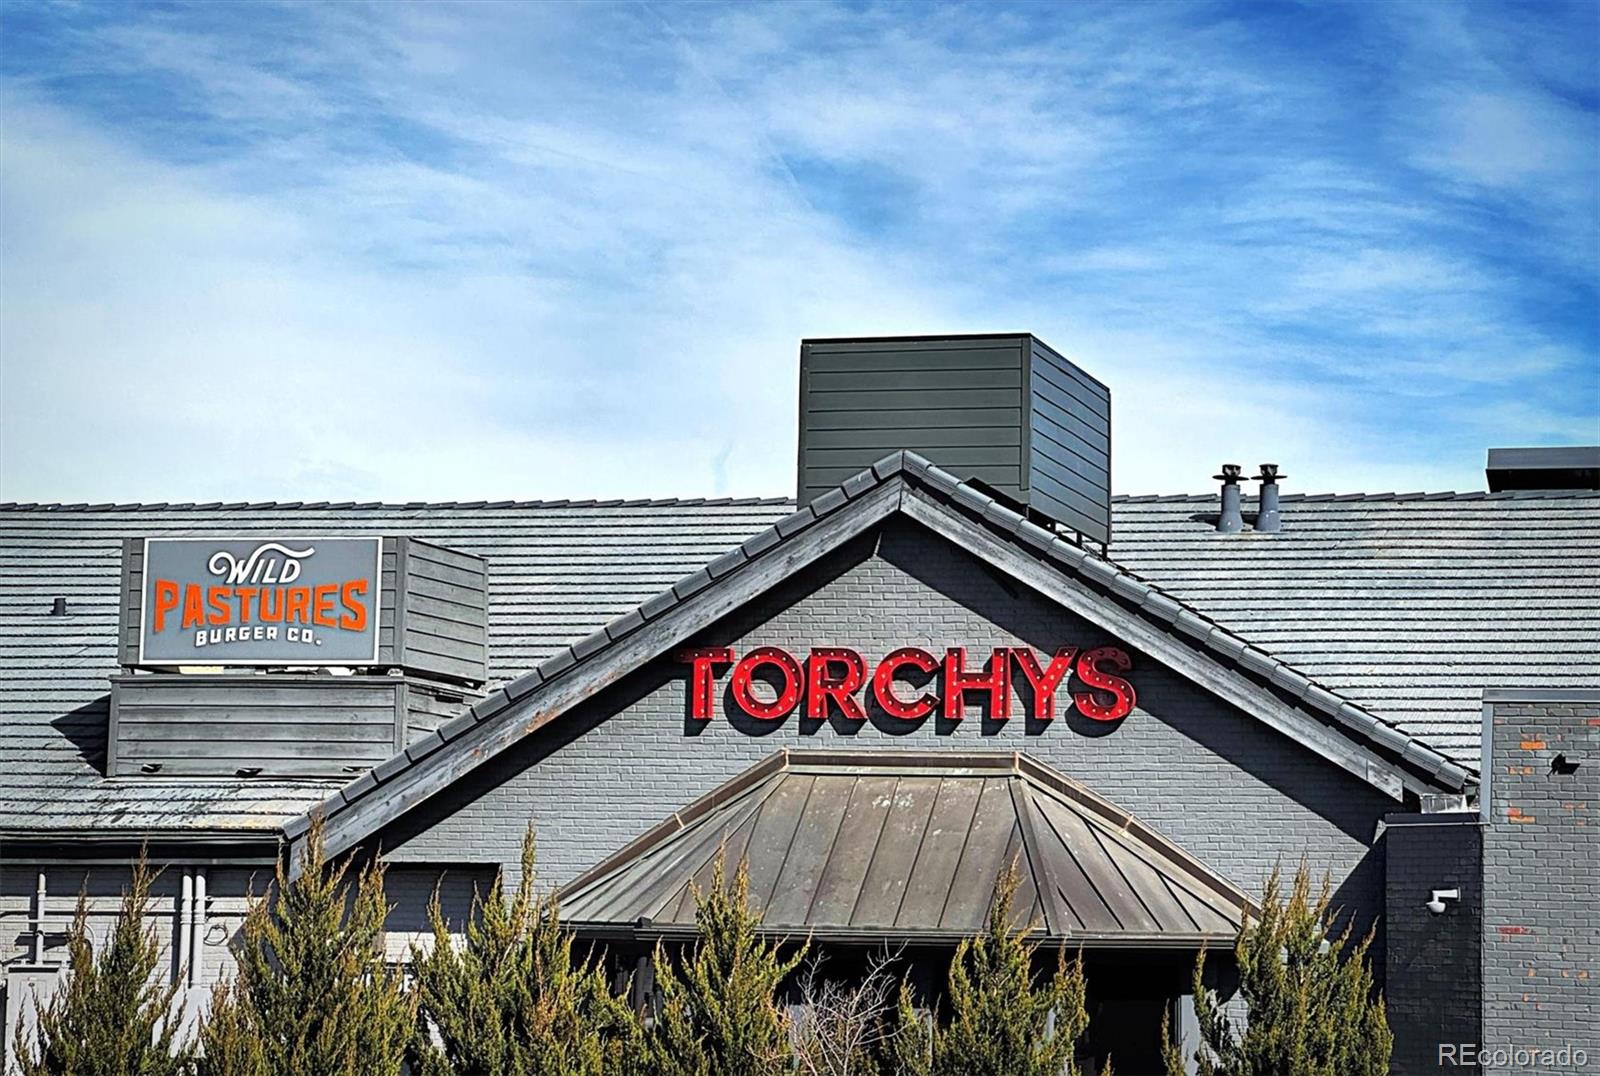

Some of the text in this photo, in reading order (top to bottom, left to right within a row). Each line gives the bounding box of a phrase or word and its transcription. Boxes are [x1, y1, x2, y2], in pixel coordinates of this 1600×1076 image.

[209, 543, 315, 584] WILD
[154, 579, 368, 631] PASTURES
[195, 626, 322, 647] BURGER CO.
[678, 646, 1136, 720] TORCHYS
